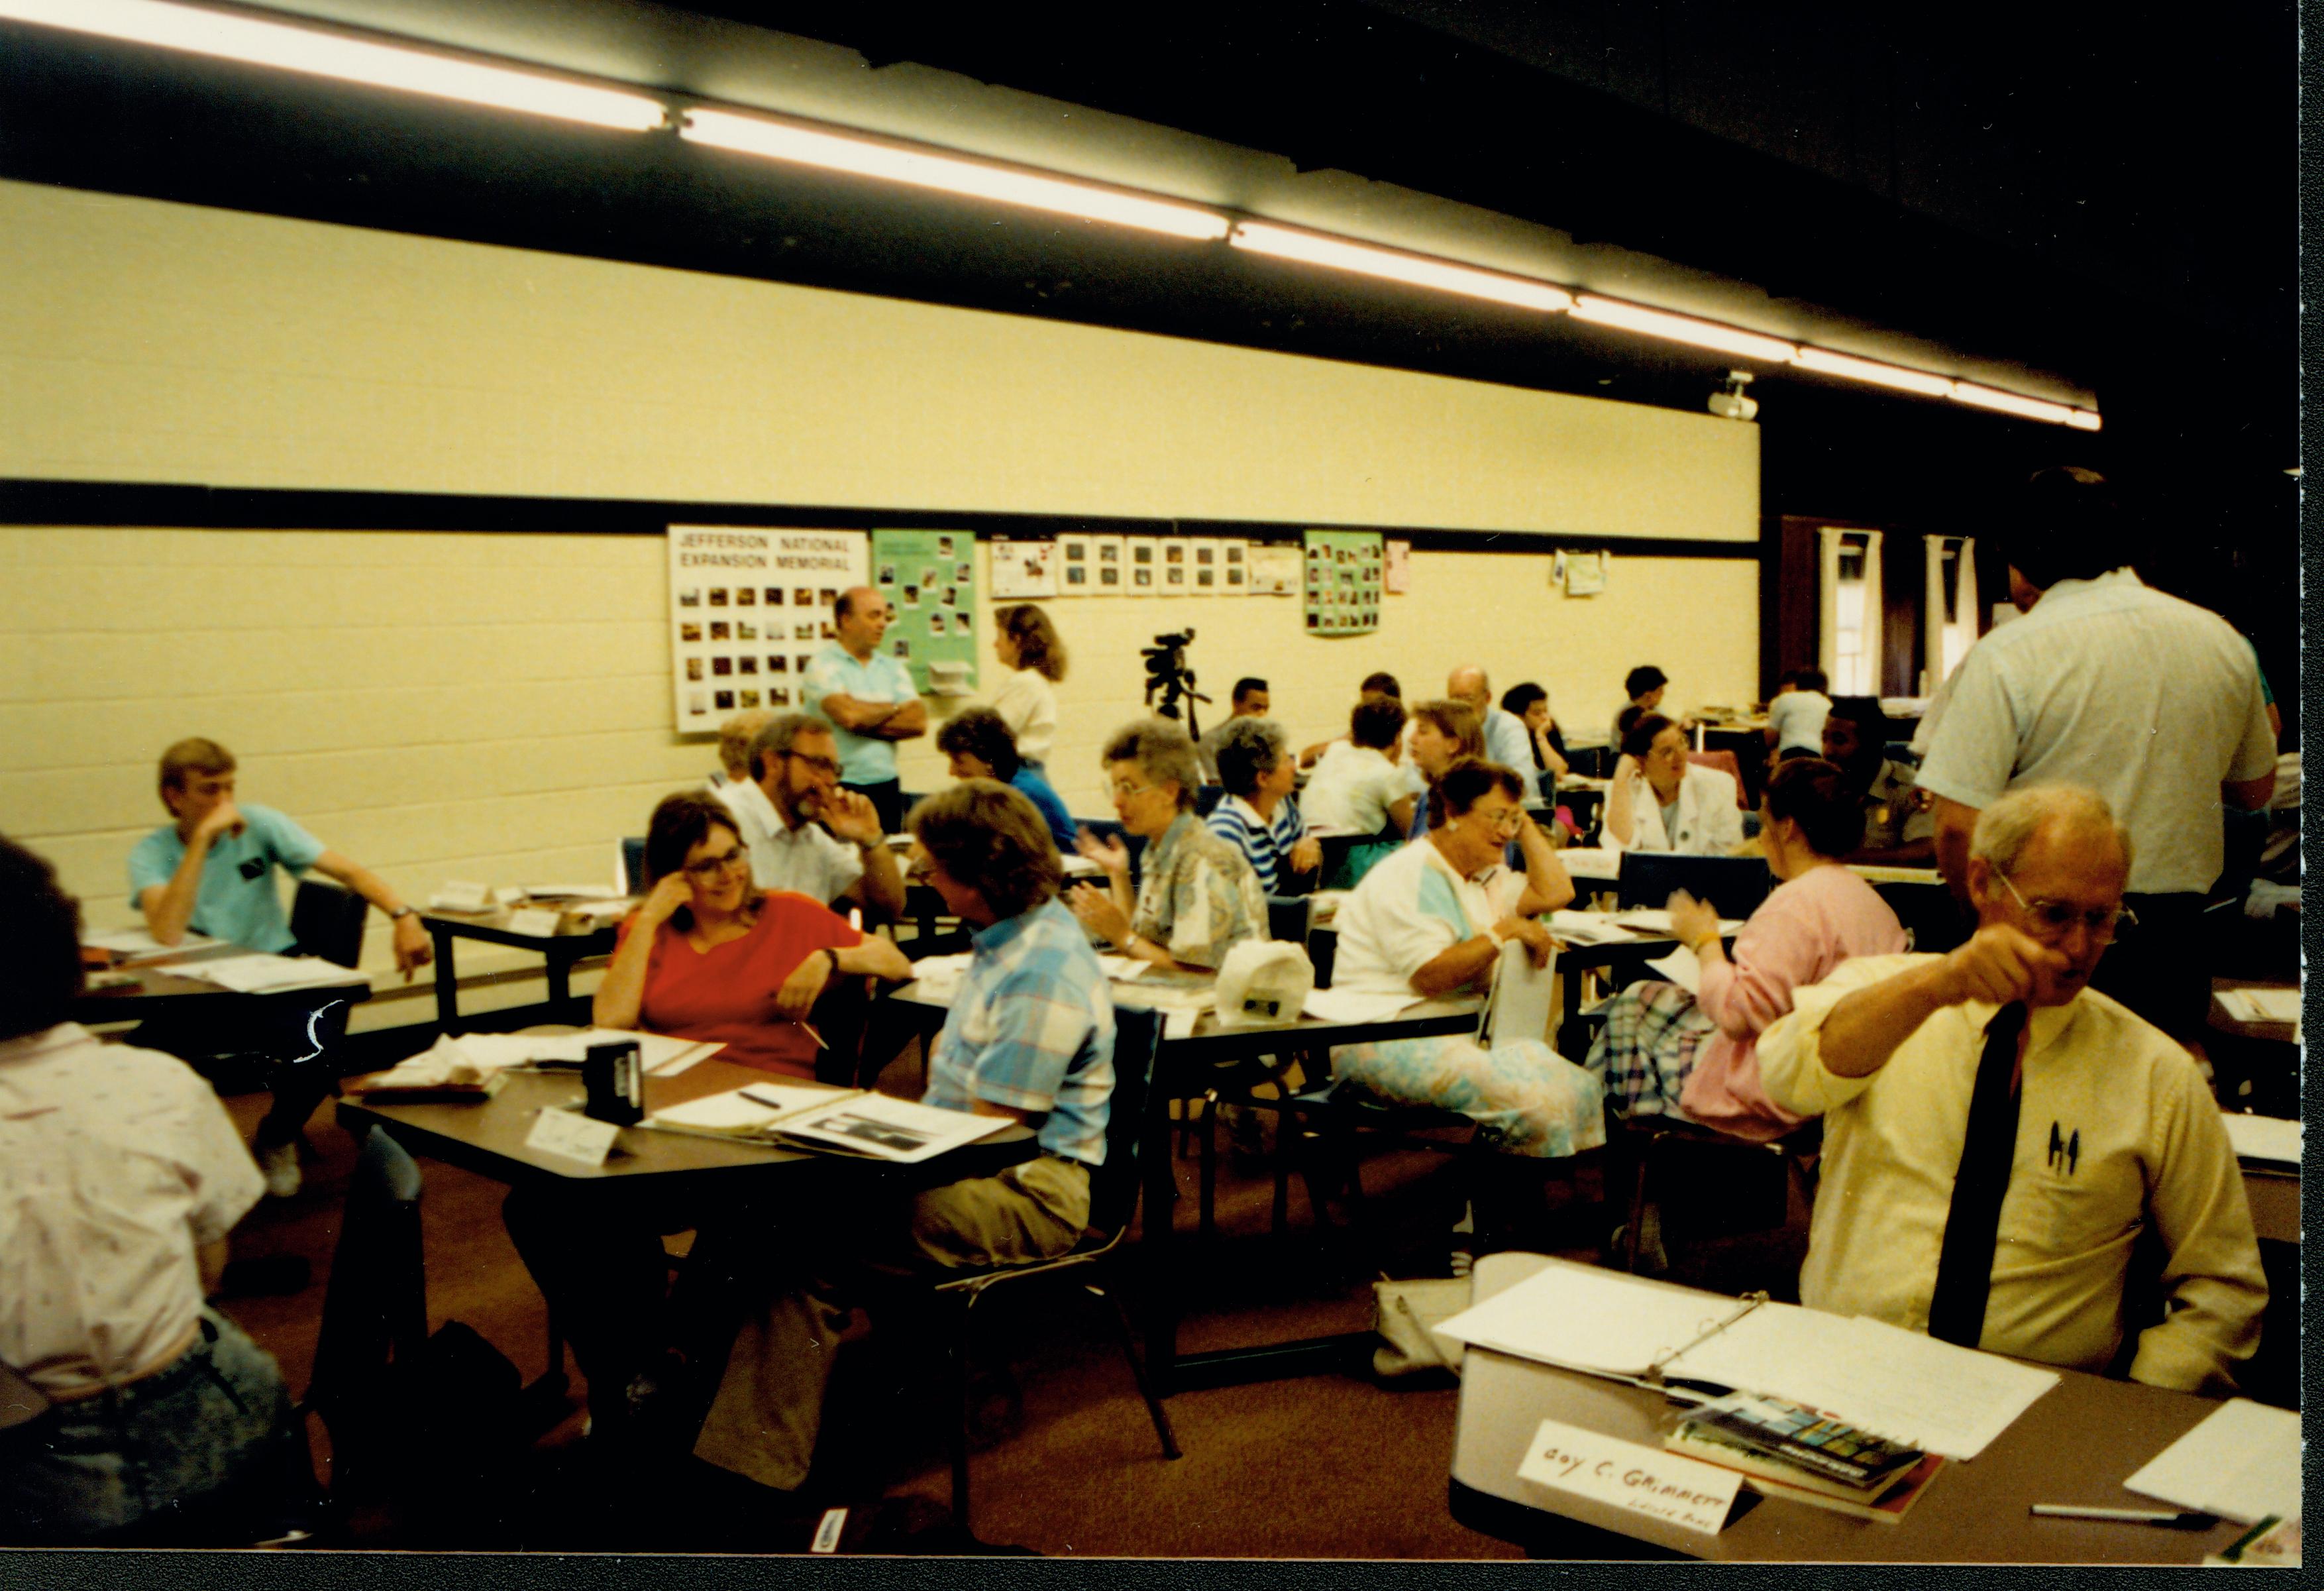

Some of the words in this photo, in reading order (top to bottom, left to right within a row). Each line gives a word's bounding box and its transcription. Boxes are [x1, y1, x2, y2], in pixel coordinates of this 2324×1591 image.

[679, 533, 768, 549] JEFFERSON
[780, 537, 849, 553] NATIONAL
[680, 552, 768, 568] EXPANSION
[775, 555, 851, 571] MEMORIAL
